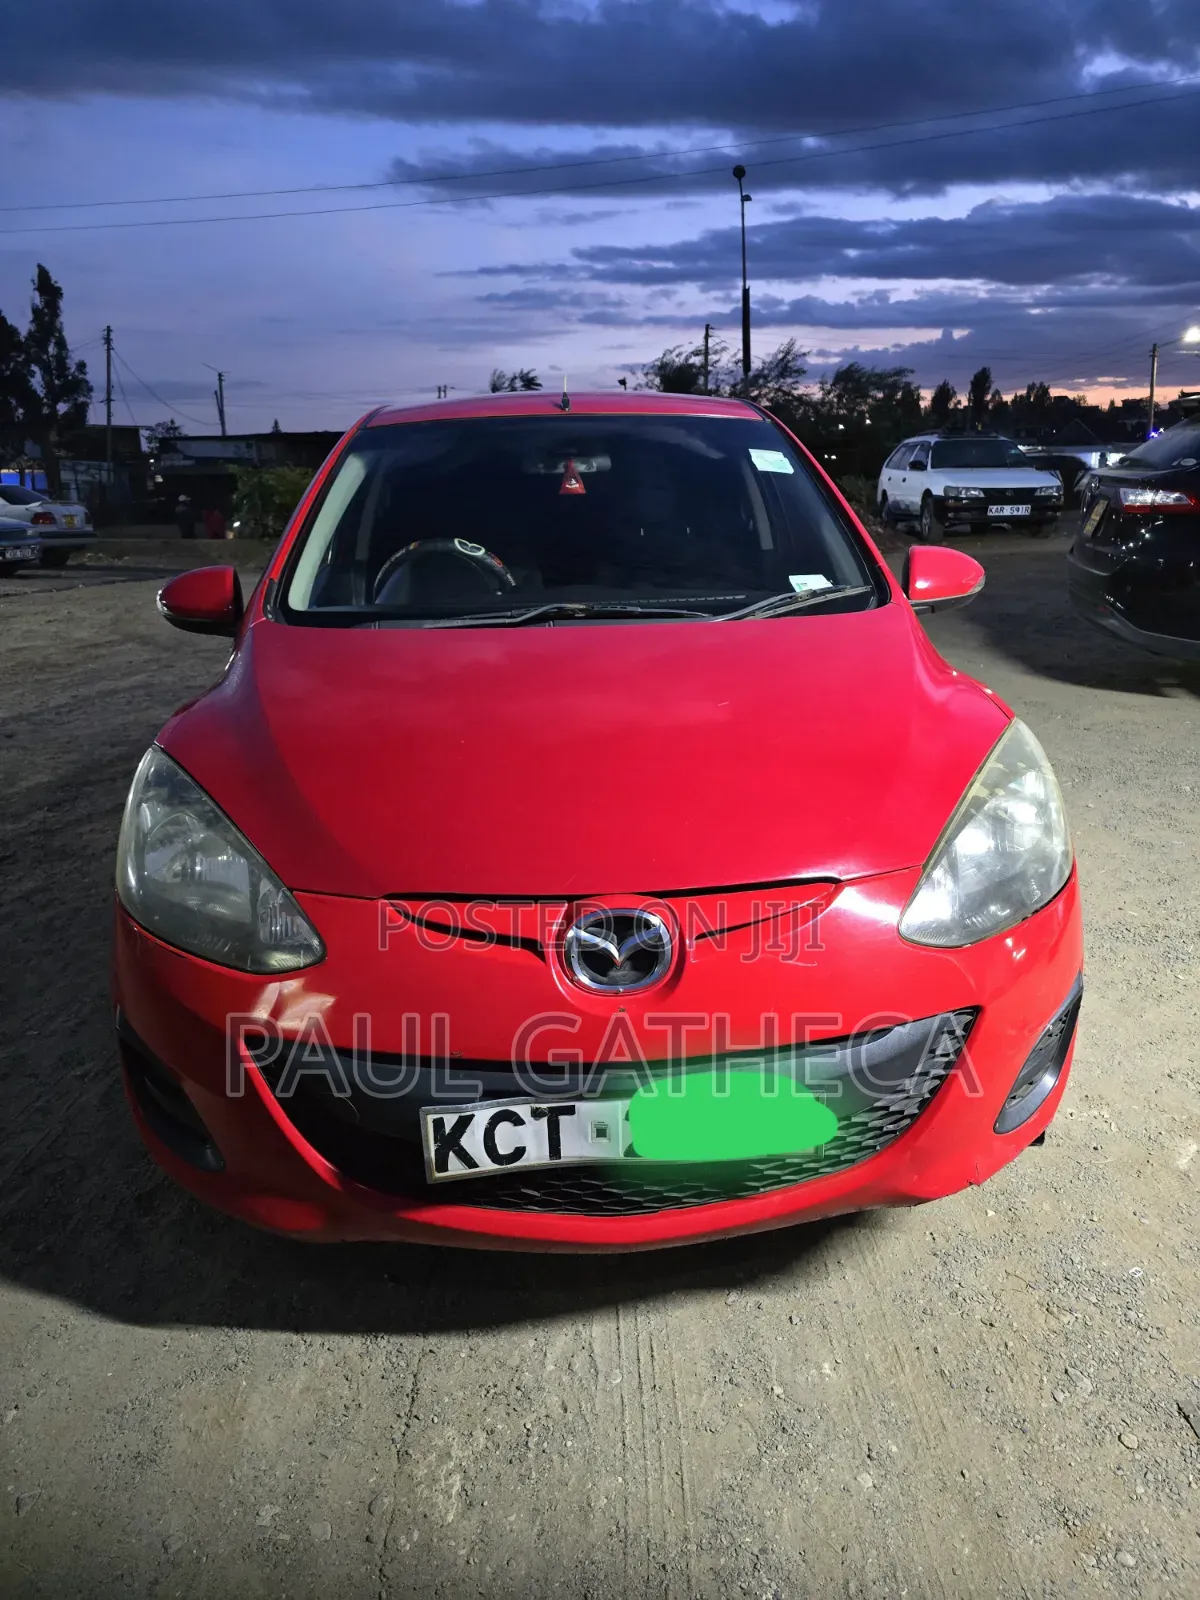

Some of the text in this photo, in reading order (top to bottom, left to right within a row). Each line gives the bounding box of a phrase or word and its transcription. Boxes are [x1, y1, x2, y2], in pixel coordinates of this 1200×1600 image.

[988, 506, 1030, 515] KAR 591R
[432, 1104, 576, 1174] KCT
